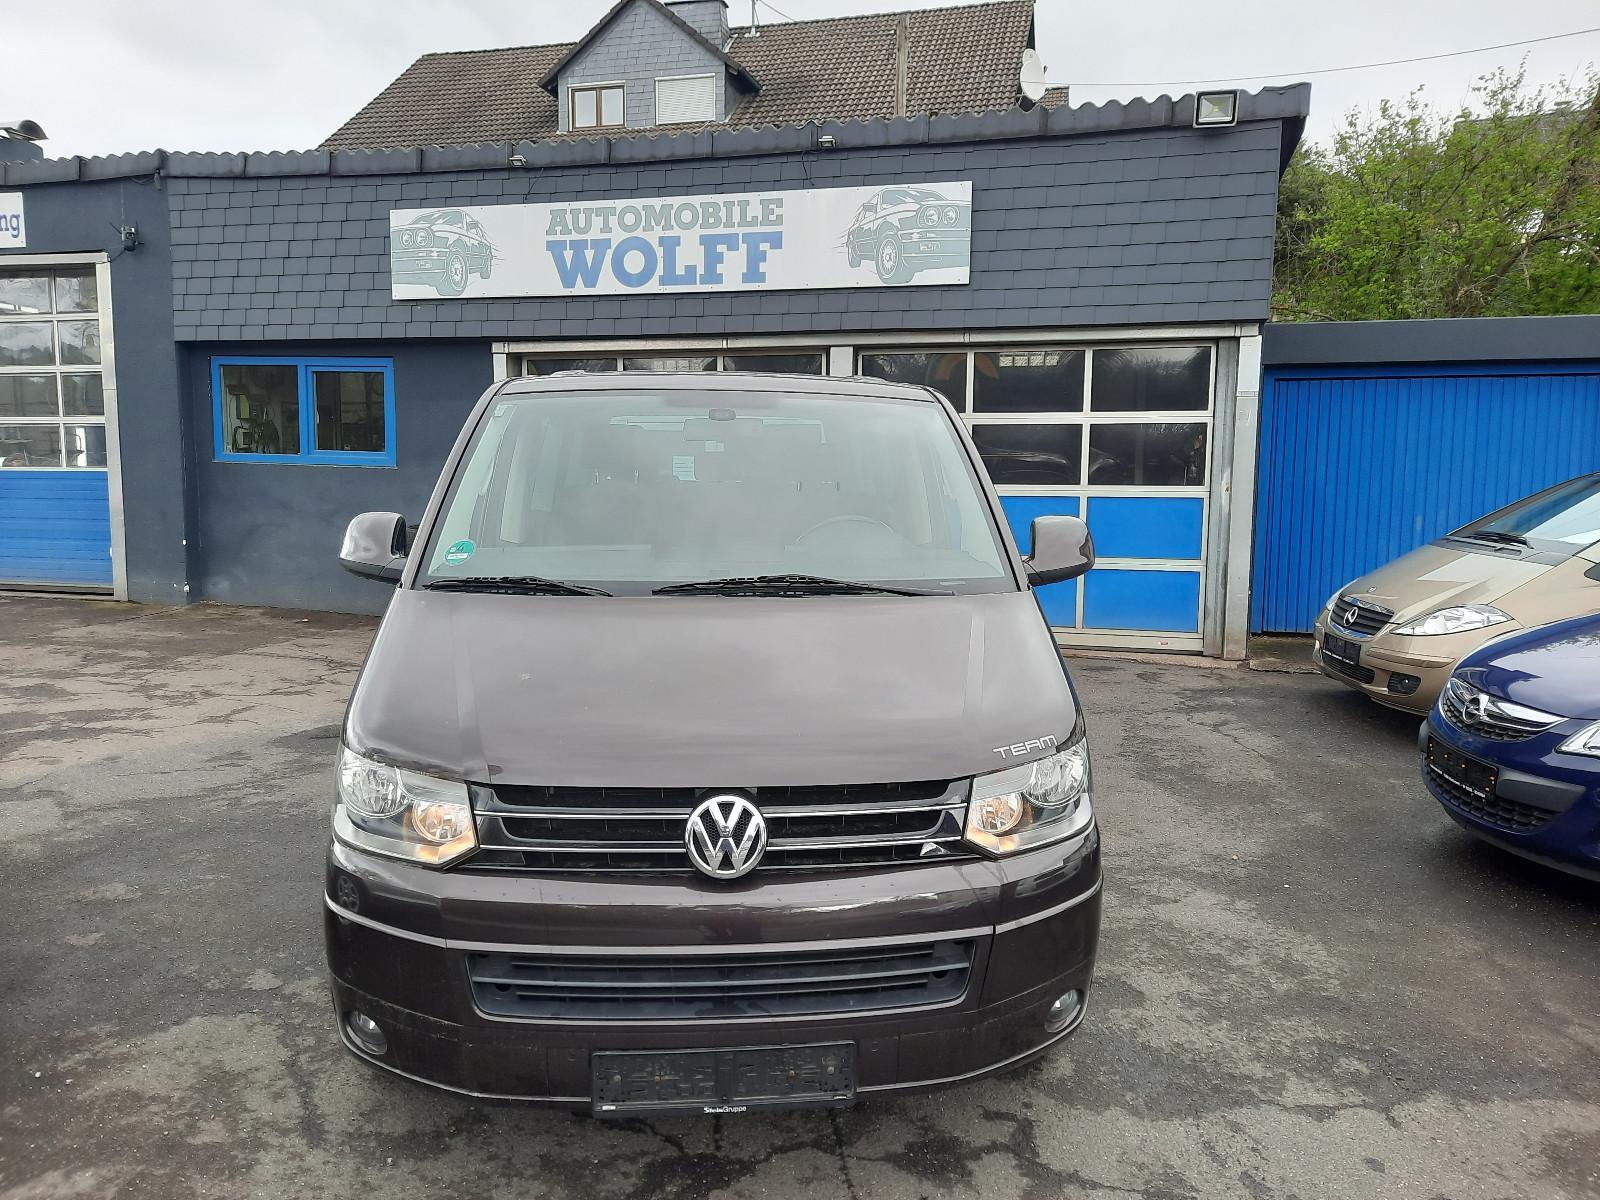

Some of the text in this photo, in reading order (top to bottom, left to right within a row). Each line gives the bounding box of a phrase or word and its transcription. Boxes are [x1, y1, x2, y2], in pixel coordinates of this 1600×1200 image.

[546, 198, 784, 235] AUTOMOBILE
[546, 231, 783, 288] WOLFF
[992, 735, 1058, 758] TEAM
[685, 795, 767, 879] VW
